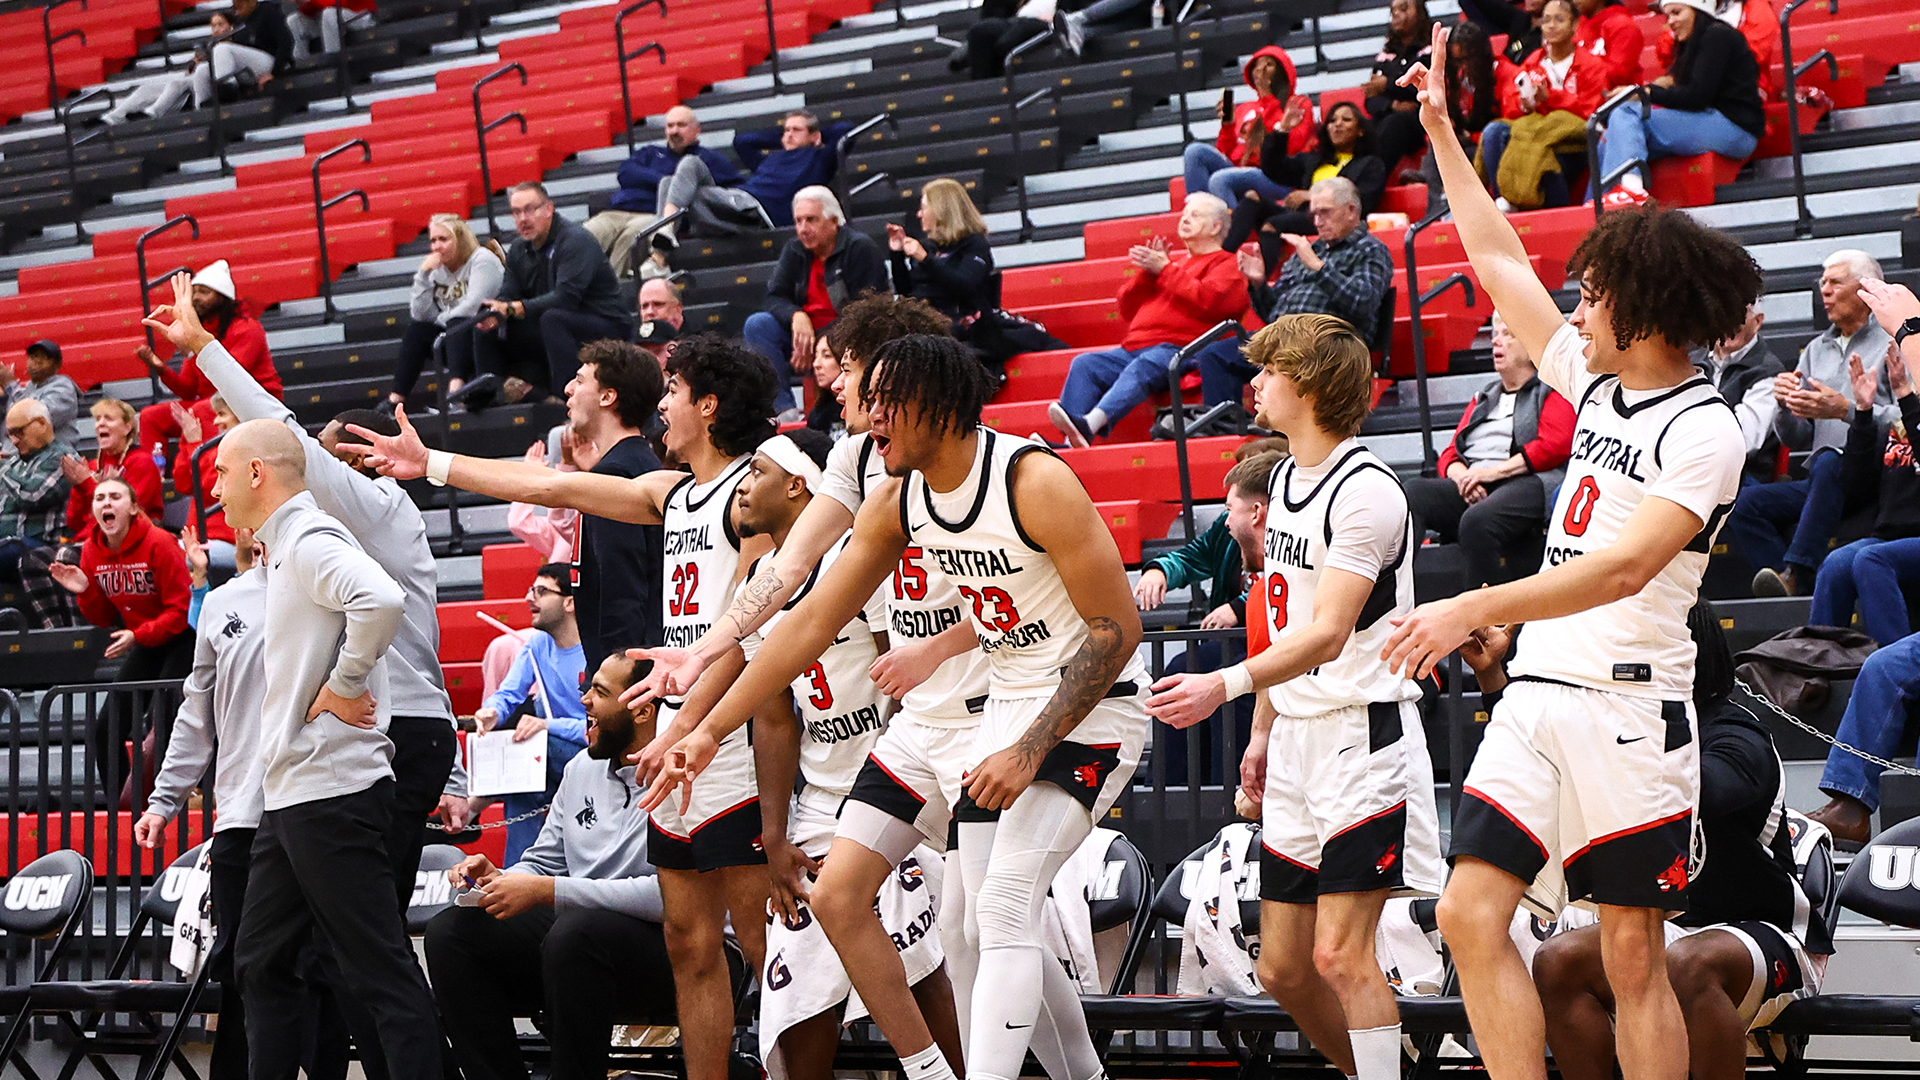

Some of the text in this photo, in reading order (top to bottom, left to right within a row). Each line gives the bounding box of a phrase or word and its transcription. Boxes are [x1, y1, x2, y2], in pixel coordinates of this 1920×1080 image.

[1571, 429, 1645, 483] CENTRAL
[1563, 475, 1600, 537] 0
[665, 524, 713, 555] CENTRAL
[1265, 527, 1314, 570] ENTRAL
[669, 561, 699, 617] 32
[894, 546, 928, 601] 15
[889, 604, 961, 638] SSOURI
[958, 585, 1021, 633] 23
[803, 660, 834, 711] 3
[5, 873, 73, 911] UCM
[409, 869, 453, 908] CM
[1869, 845, 1920, 891] U
[889, 903, 937, 953] RAD
